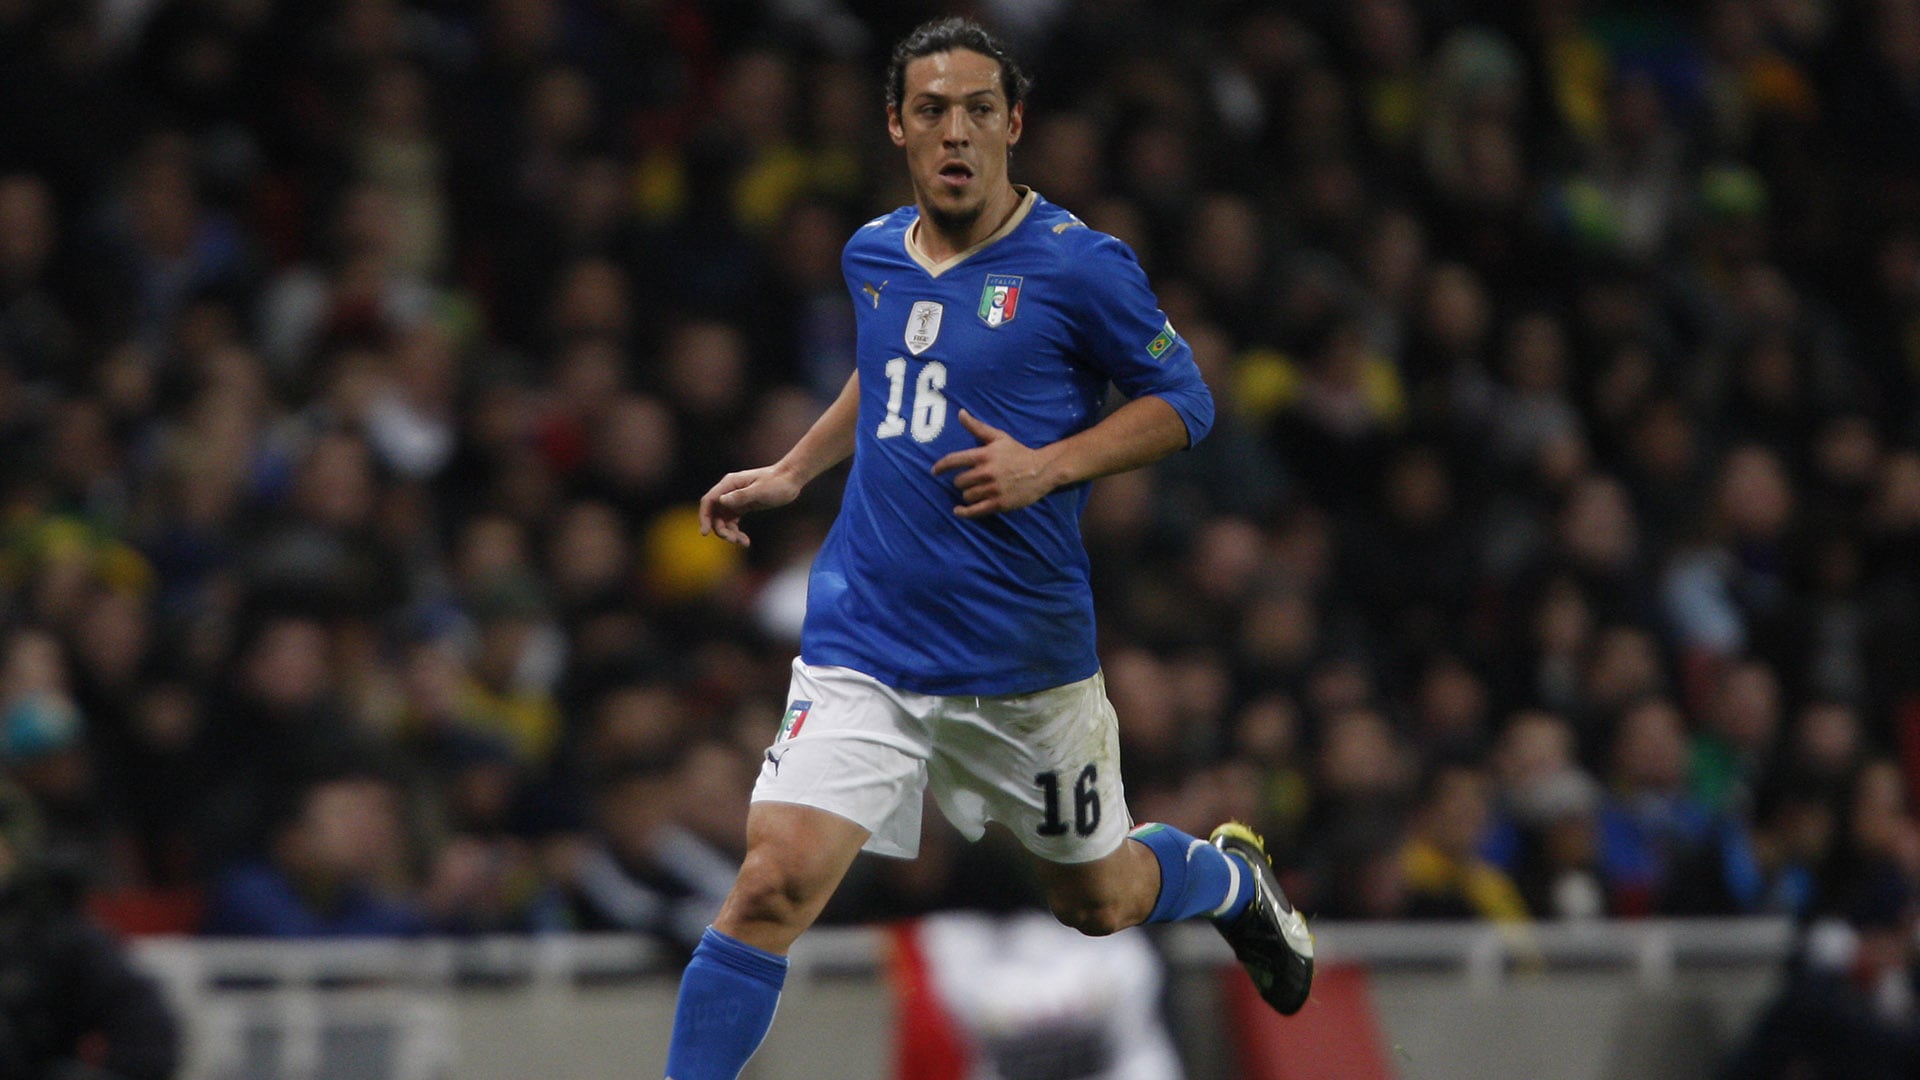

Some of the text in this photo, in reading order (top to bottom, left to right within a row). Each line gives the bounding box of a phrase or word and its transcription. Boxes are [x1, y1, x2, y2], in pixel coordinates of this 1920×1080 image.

[990, 278, 1017, 286] ITALIA
[876, 357, 947, 443] 16
[1034, 762, 1101, 839] 16
